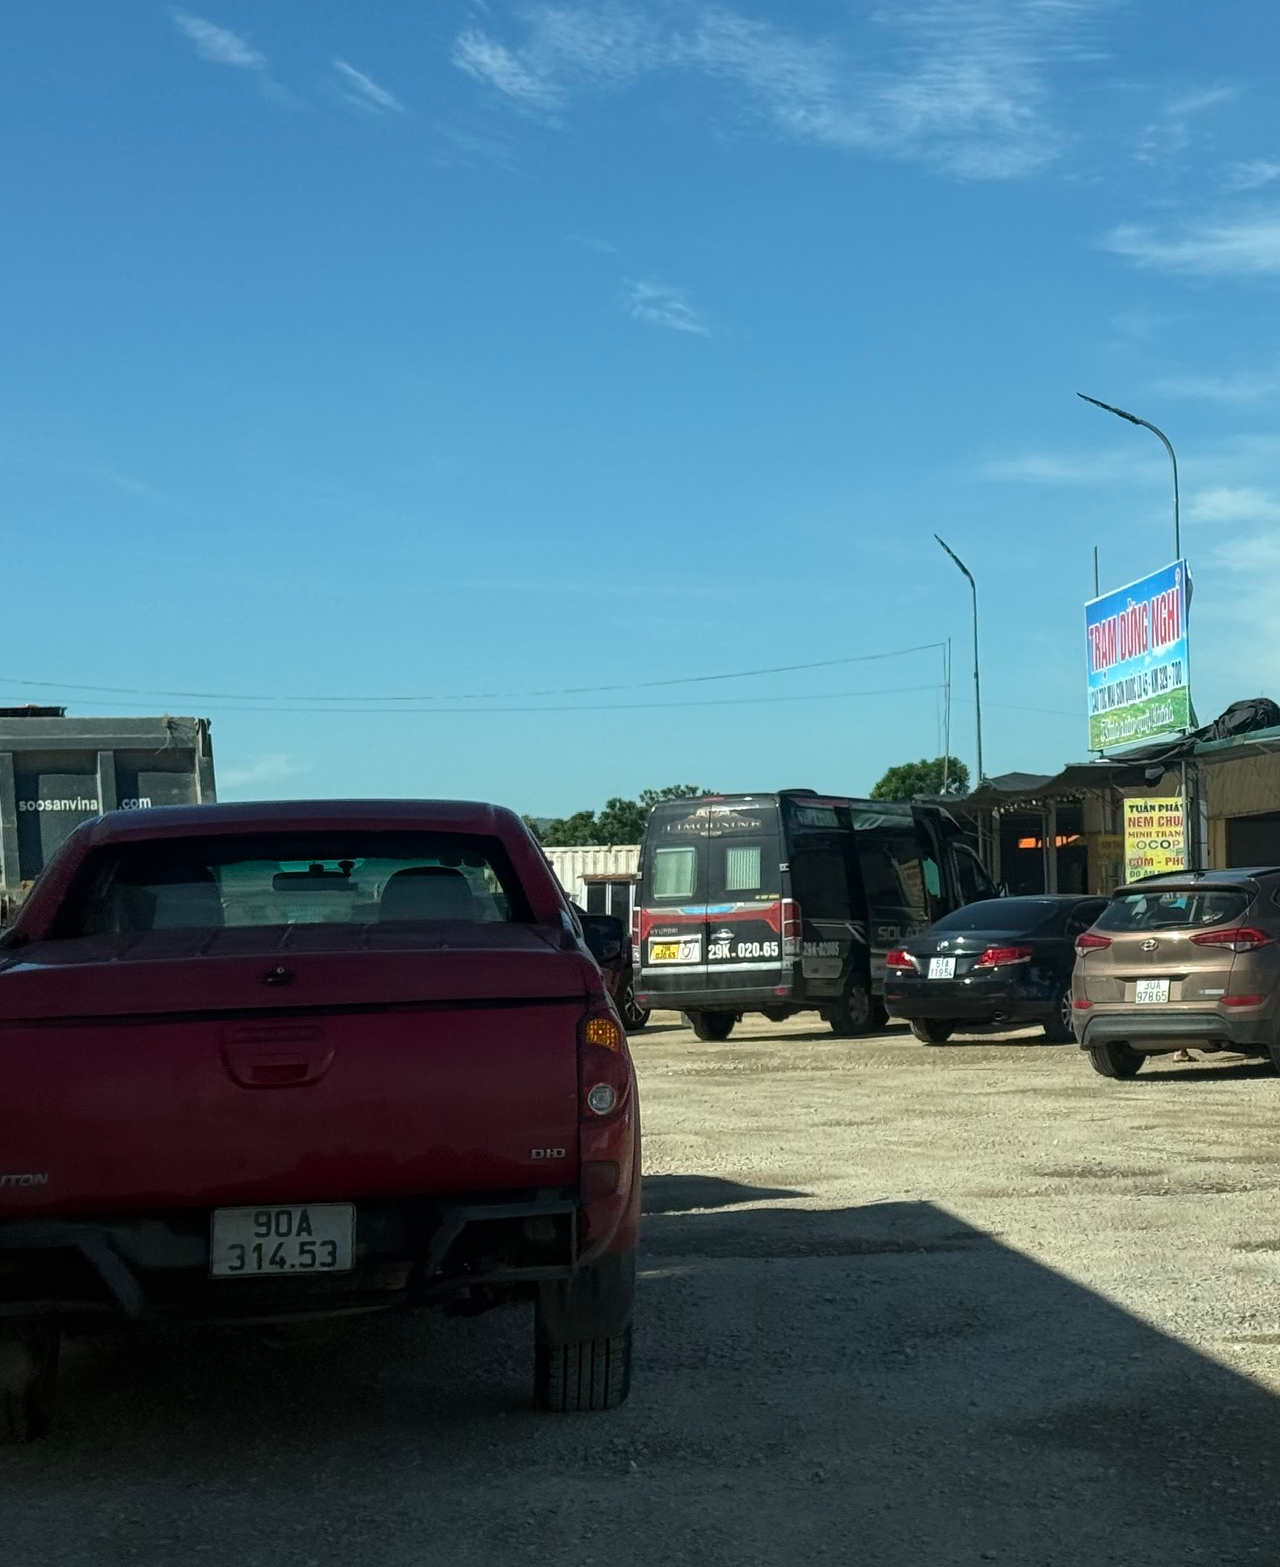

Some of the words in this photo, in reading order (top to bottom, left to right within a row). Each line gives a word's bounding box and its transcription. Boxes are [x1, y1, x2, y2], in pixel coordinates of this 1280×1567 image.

[1089, 615, 1118, 678] TRẠM
[1120, 598, 1149, 662] DỪNG
[1151, 567, 1182, 649] NGHỈ
[19, 796, 98, 811] soosanvina
[119, 796, 151, 810] .com
[1128, 801, 1156, 813] TUẤN
[1128, 816, 1153, 828] NEM
[1136, 840, 1180, 850] OCOP
[253, 1209, 313, 1238] 90A
[228, 1240, 338, 1271] 314.53
